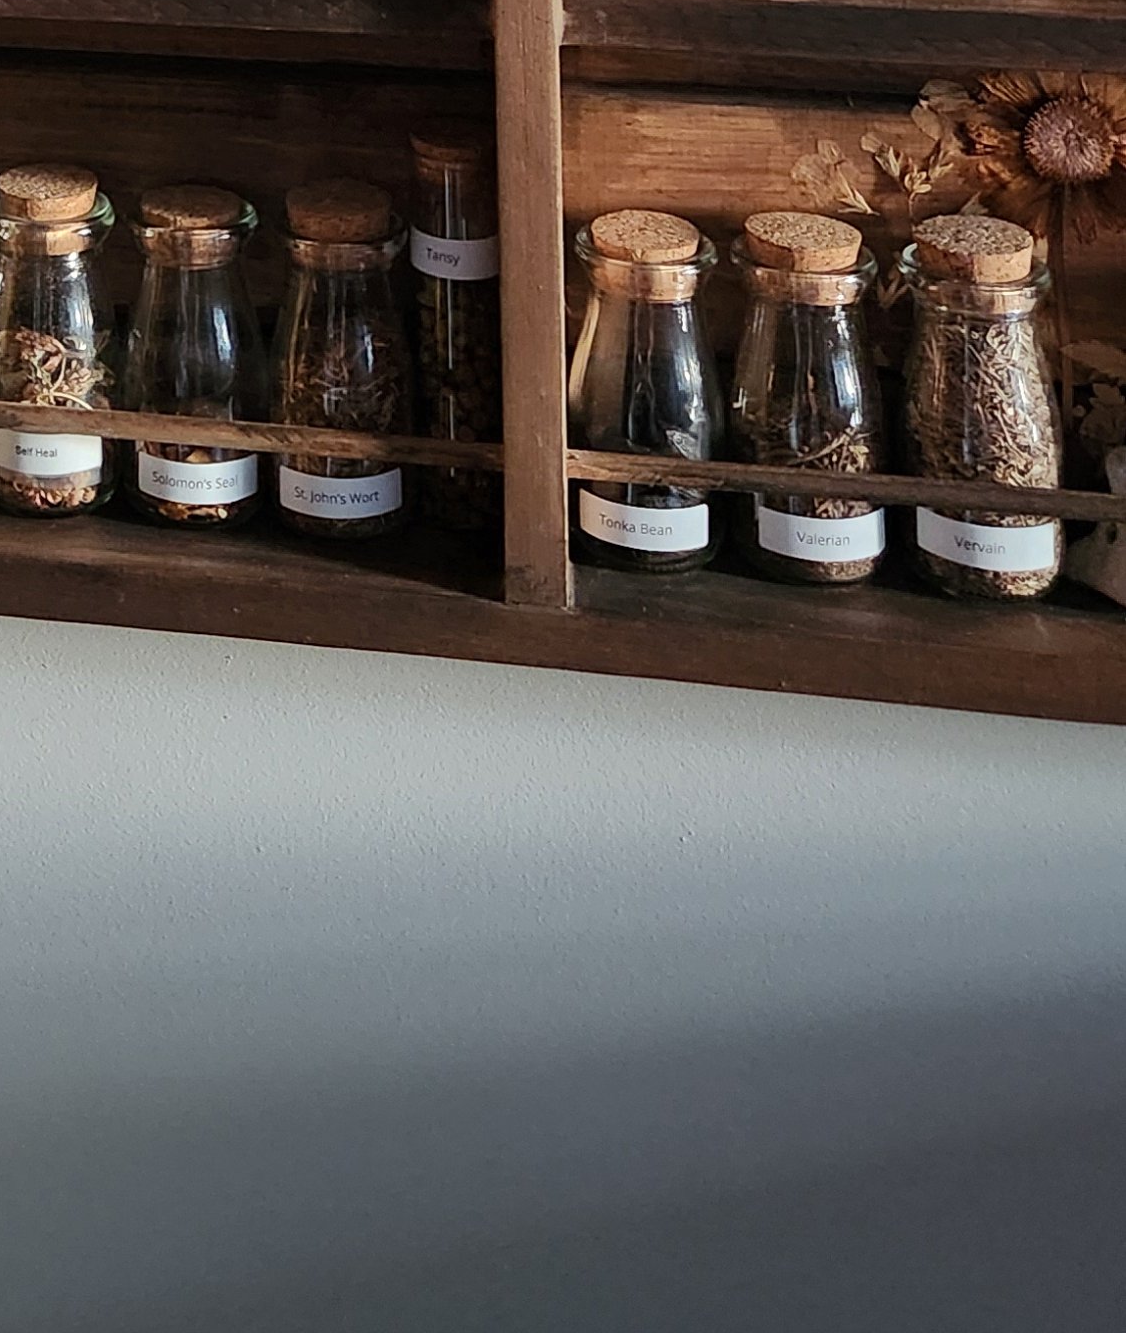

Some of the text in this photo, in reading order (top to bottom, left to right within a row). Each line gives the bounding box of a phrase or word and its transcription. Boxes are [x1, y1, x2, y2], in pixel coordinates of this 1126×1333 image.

[426, 246, 460, 267] Tansy
[15, 445, 58, 458] Self Heal
[151, 471, 239, 490] Solomon's Seal
[294, 486, 381, 505] St. John's Wort
[599, 513, 673, 536] Tonka Bean
[796, 531, 850, 546] Valerian
[954, 535, 1006, 554] Vervain
